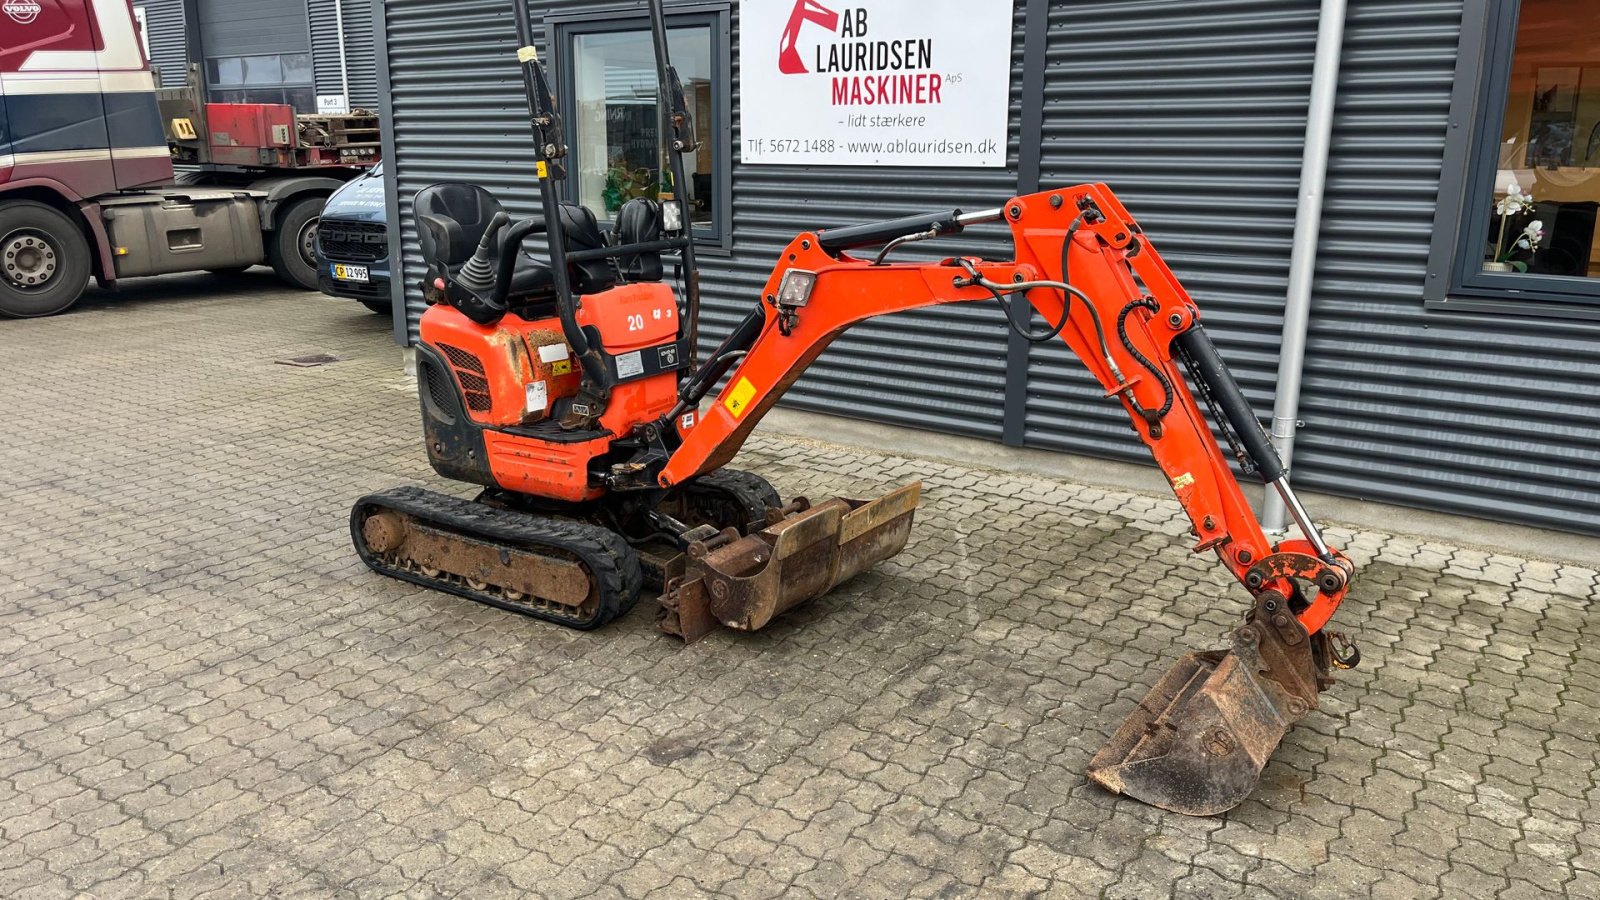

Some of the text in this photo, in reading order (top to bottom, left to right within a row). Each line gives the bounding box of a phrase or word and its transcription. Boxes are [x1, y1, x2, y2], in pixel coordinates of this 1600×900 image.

[841, 8, 868, 38] AB
[816, 38, 932, 73] LAURIDSEN
[832, 72, 963, 105] MASKINER ApS
[847, 114, 867, 128] lidt
[870, 114, 926, 127] stærkere
[748, 139, 766, 155] Tlf.
[770, 140, 800, 152] 5672
[804, 140, 835, 152] 1488
[847, 139, 997, 154] www.ablauridsen.dk
[335, 266, 344, 276] CP
[627, 314, 644, 331] 20
